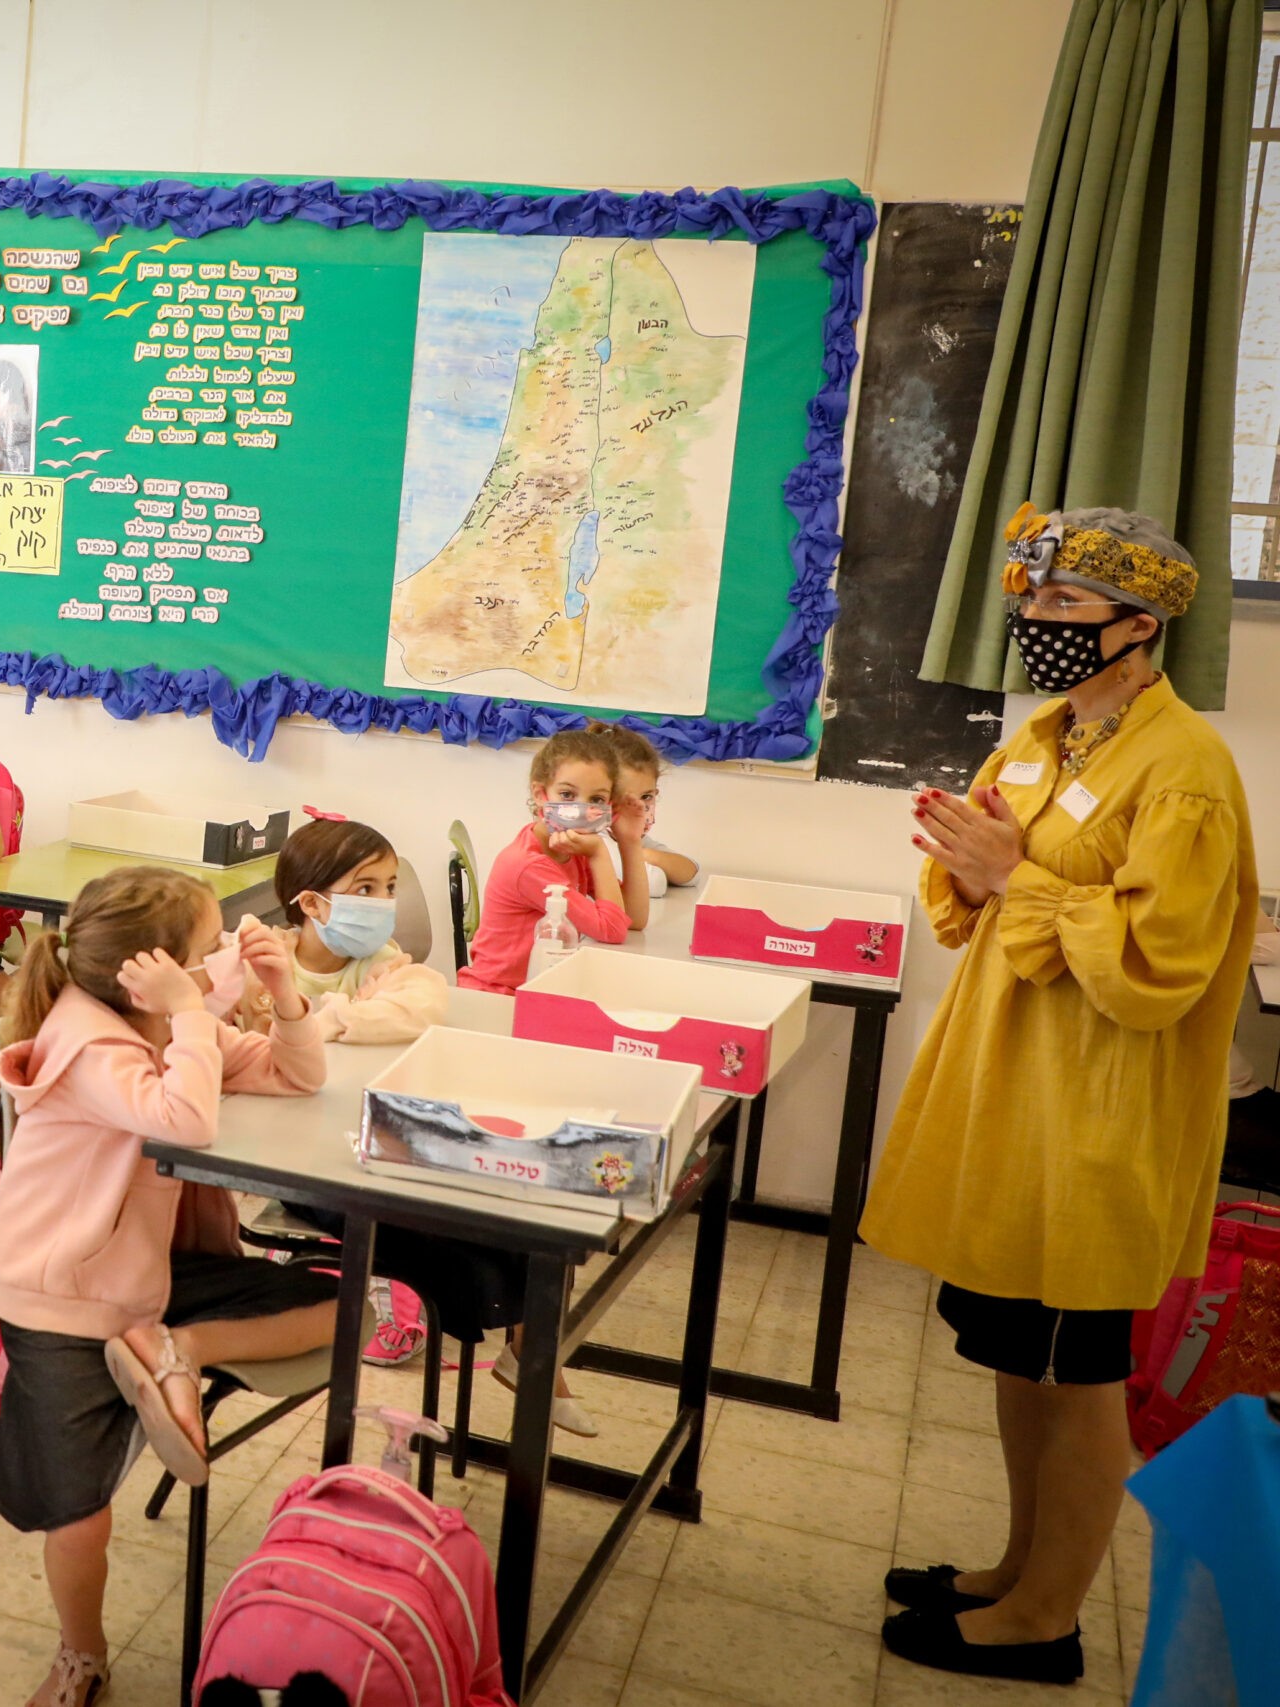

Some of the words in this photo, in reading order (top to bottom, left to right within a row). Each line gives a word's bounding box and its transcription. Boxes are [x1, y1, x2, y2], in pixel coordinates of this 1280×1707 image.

[139, 265, 161, 279] ויבין
[171, 266, 191, 276] ידע
[201, 266, 223, 276] איש
[231, 263, 257, 278] שכל
[267, 268, 296, 282] צריך
[4, 276, 48, 292] שמים
[64, 278, 86, 292] גם
[180, 283, 208, 300] דולק
[218, 288, 242, 298] תוכו
[253, 288, 294, 302] שבתוך
[13, 308, 68, 328] מפיקים
[638, 319, 669, 334] הבשן
[137, 344, 159, 358] ויבין
[166, 346, 186, 356] ידע
[195, 348, 218, 358] איש
[225, 344, 251, 358] שכל
[258, 349, 289, 363] וצריך
[168, 366, 206, 380] ולגלות
[215, 368, 250, 382] לעמול
[260, 369, 293, 382] שעליו
[144, 407, 176, 418] גדולה
[184, 407, 225, 424] לאבוקה
[238, 409, 289, 427] ולהדליקו
[160, 428, 195, 442] העולם
[205, 433, 224, 443] את
[235, 432, 274, 445] ולהאיר
[23, 482, 54, 497] הרב
[146, 481, 178, 493] דומה
[188, 484, 226, 497] האדם
[138, 502, 172, 515] ציפור
[183, 501, 204, 517] של
[217, 506, 257, 519] בכוחה
[10, 506, 46, 529] יצחק
[127, 519, 163, 536] מעלה
[171, 522, 208, 539] מעלה
[219, 526, 260, 540] לדאות
[17, 530, 46, 558] קוק
[79, 541, 114, 554] כנפיה
[126, 544, 146, 555] את
[157, 545, 199, 556] שתניע
[208, 547, 247, 560] בתנאי
[145, 564, 171, 579] ללא
[101, 587, 140, 599] מעופה
[152, 587, 193, 602] תפסיק
[206, 590, 226, 601] אם
[60, 603, 100, 618] ונופלת
[111, 607, 149, 619] צונחת
[161, 609, 183, 620] היא
[195, 610, 216, 621] הרי
[521, 611, 560, 655] המדבר
[769, 940, 810, 953] ליאורה
[618, 1041, 653, 1057] אילה
[496, 1160, 540, 1179] טליה
